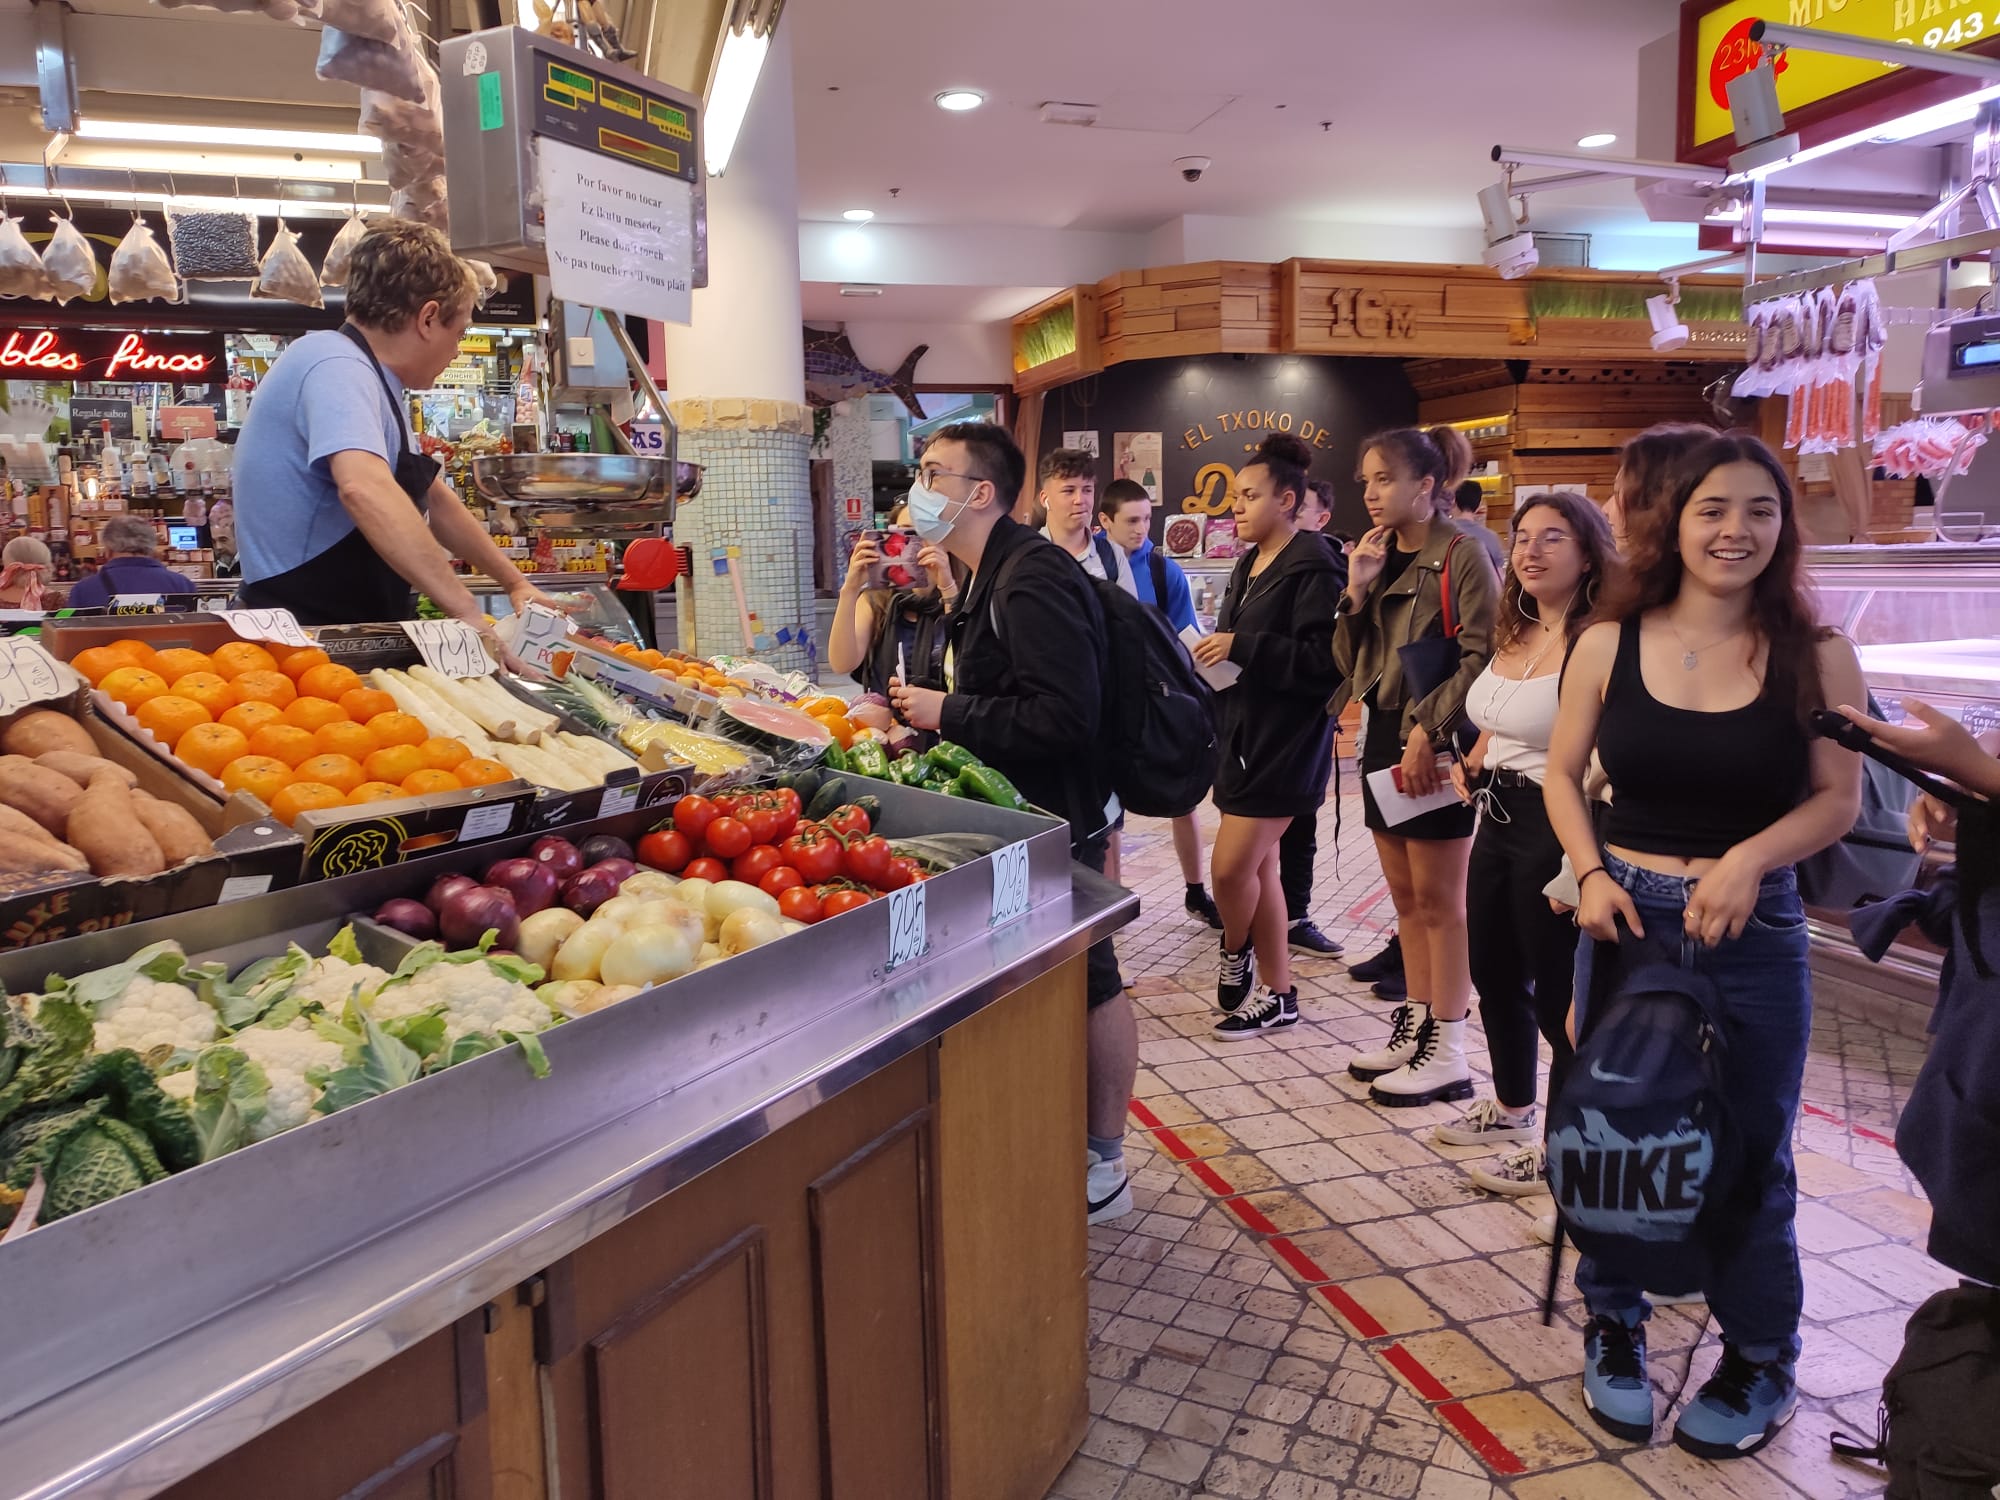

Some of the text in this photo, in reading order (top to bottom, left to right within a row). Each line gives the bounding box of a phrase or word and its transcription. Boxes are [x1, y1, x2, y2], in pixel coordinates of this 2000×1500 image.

[1923, 12, 1983, 49] 943
[577, 173, 663, 209] Por favor no tocar
[581, 201, 594, 216] Ez
[624, 216, 662, 234] mesedez
[580, 229, 610, 248] Please
[554, 250, 568, 265] Ne
[571, 256, 588, 270] pas
[590, 261, 627, 277] toucher
[645, 274, 665, 287] vous
[105, 333, 210, 378] finos
[1183, 409, 1330, 449] EL TXOKO DE
[1561, 1140, 1702, 1211] NIKE
